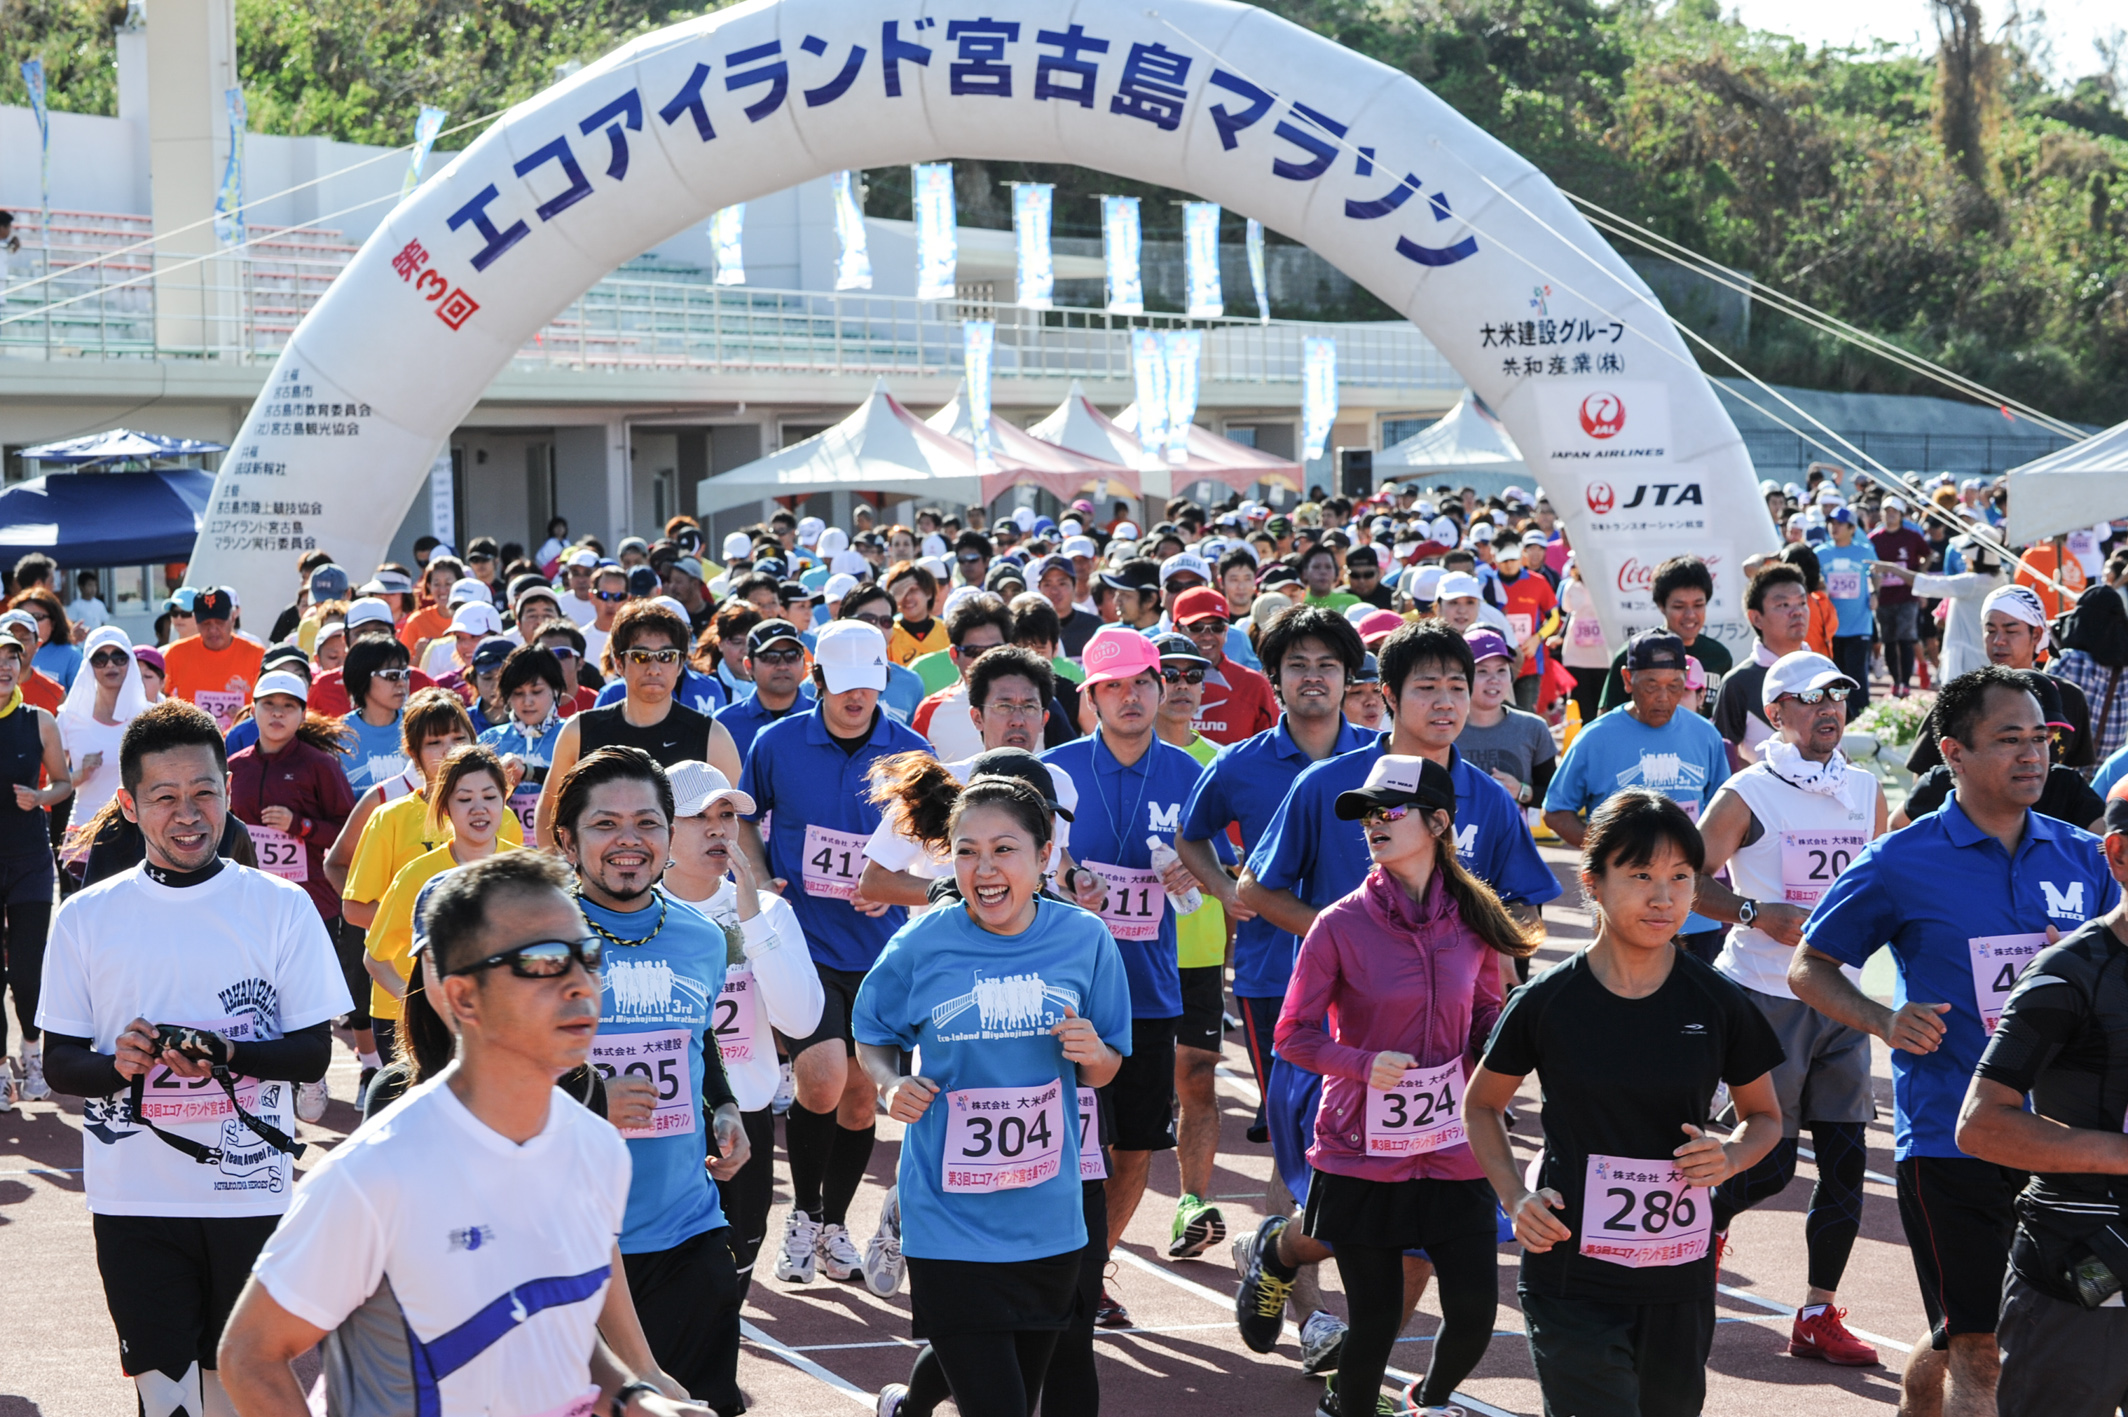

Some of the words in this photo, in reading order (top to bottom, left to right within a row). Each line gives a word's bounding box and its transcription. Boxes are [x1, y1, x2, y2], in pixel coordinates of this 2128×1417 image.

[446, 15, 1478, 271] エコアイランド宮古島マラソン
[392, 238, 480, 331] 第3回
[1479, 318, 1625, 347] 大米建設グループ
[273, 385, 313, 399] 宮古島市
[264, 403, 372, 418] 宮古島市教育委員会
[1591, 424, 1617, 435] JAL
[1551, 450, 1591, 459] JAPAN
[1596, 448, 1665, 458] AIRLINES
[1622, 484, 1704, 508] JTA
[217, 501, 322, 516] 宮古島市陸上競技協会
[210, 520, 303, 535] エコアイランド宮古島
[214, 536, 316, 550] マラソン実行委員会
[1832, 579, 1857, 591] 250
[1093, 648, 1117, 660] STAFF
[1189, 720, 1228, 732] IZUNO
[1148, 801, 1181, 832] M
[2039, 881, 2084, 918] M
[1994, 945, 2034, 956] 株式会社
[673, 999, 692, 1014] 3rd
[937, 1031, 980, 1042] Eco-Island
[592, 1047, 637, 1057] 株式会社
[643, 1038, 683, 1054] 大米建設
[971, 1100, 1011, 1110] 株式会社
[1017, 1088, 1057, 1110] 大米建設
[1382, 1082, 1456, 1129] 324
[962, 1109, 1052, 1158] 304
[1371, 1126, 1465, 1152] 第3回エコアイランド宮古島マラソ
[225, 1150, 244, 1166] Team
[244, 1149, 267, 1166] Angel
[948, 1160, 1058, 1187] 第3回エコアイランド宮古島マラソン
[1613, 1170, 1660, 1182] 株式会社
[1603, 1184, 1696, 1234] 286
[1586, 1239, 1707, 1262] 第3回エコアイランド宮古島マラソン
